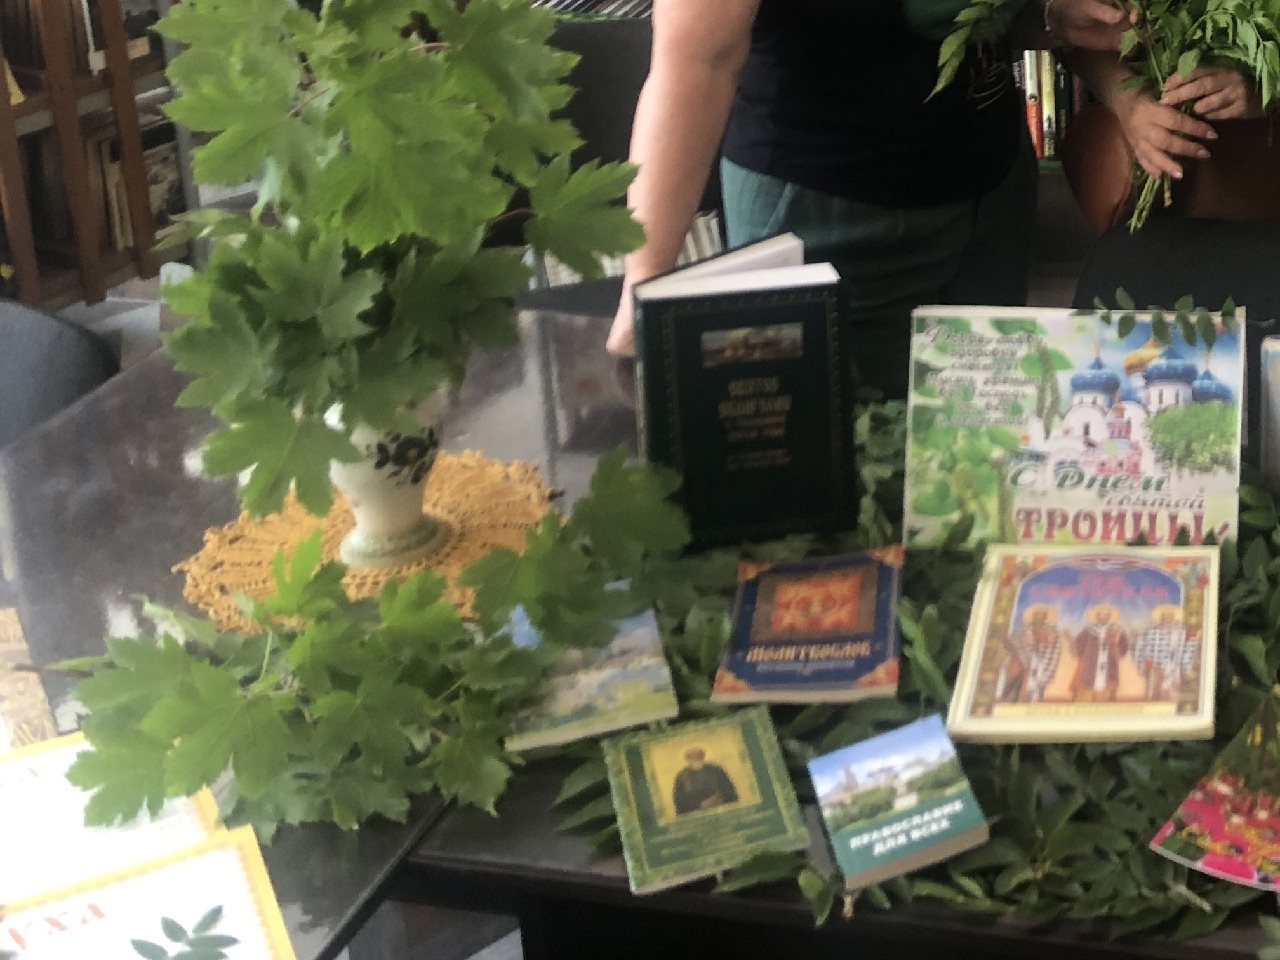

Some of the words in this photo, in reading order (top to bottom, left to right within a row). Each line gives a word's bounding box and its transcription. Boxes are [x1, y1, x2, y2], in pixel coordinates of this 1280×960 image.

[1009, 461, 1042, 487] С
[1053, 464, 1171, 490] Днем
[849, 798, 964, 849] ПРАВОСЛАВИЕ
[872, 832, 909, 857] ДЛЯ
[910, 817, 951, 842] ВСЕХ
